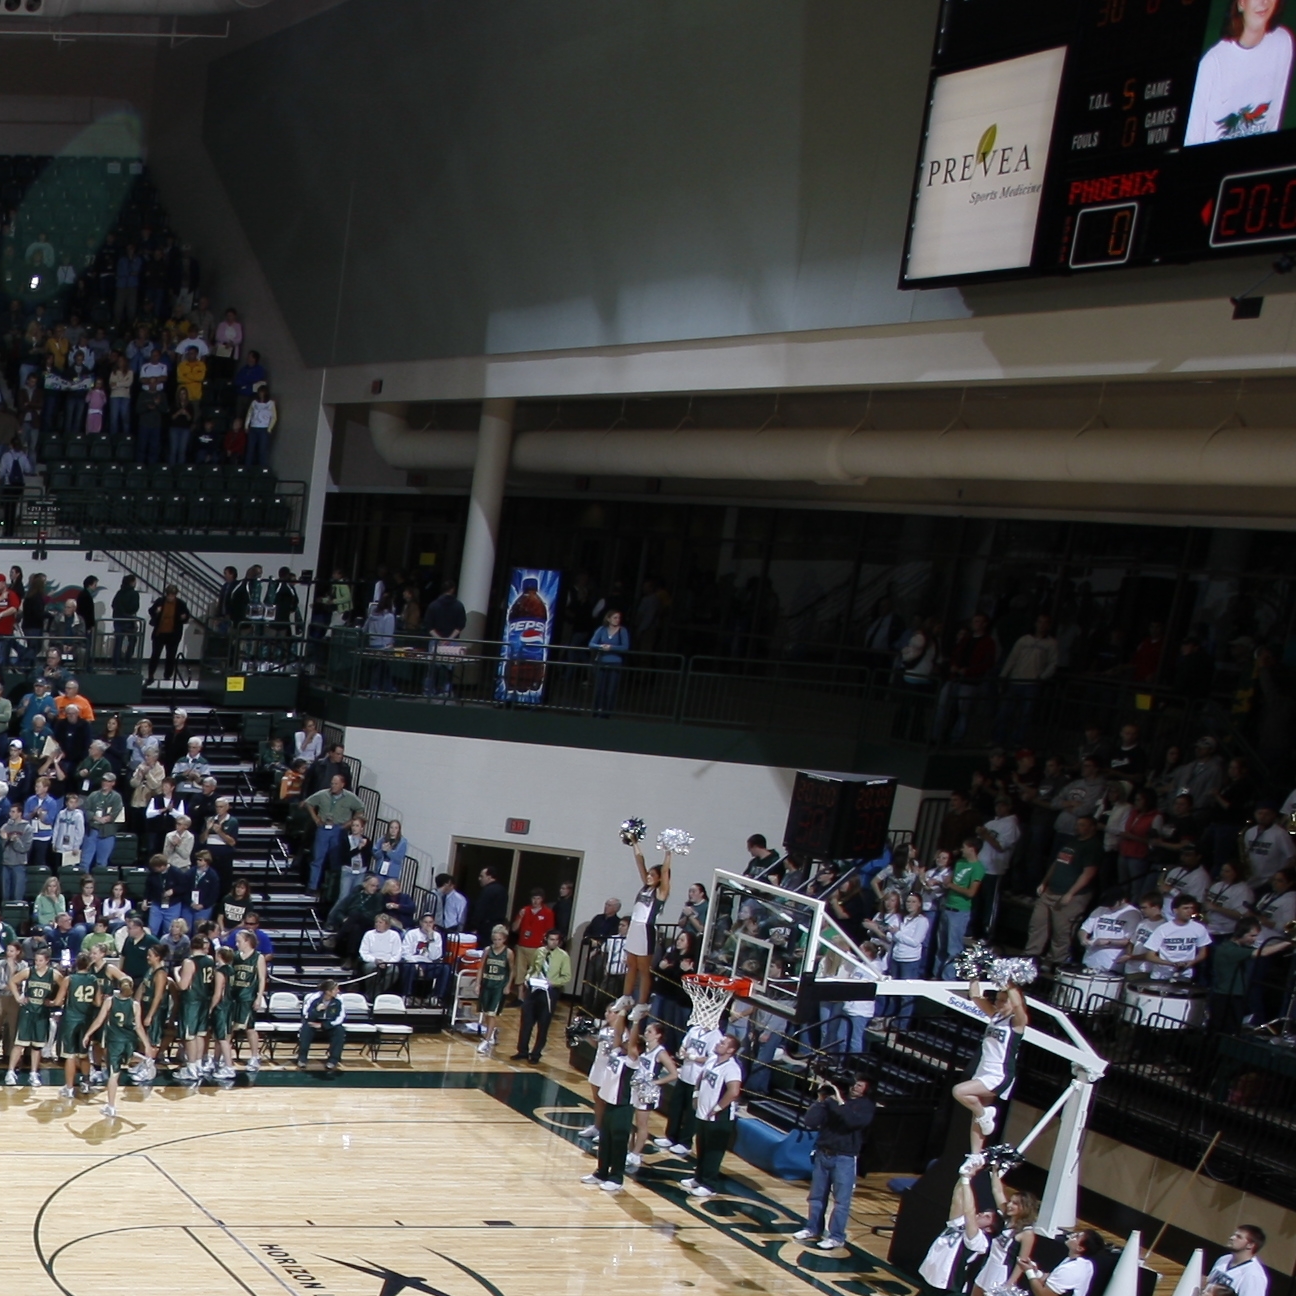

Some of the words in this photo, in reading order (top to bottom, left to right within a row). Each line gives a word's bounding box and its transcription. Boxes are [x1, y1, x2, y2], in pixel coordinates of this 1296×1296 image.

[1144, 80, 1171, 101] GAME
[1144, 107, 1177, 129] GAMES
[1070, 131, 1100, 152] FOULS
[1146, 127, 1169, 145] WON
[926, 144, 1032, 187] PREVEA
[968, 187, 999, 205] Sports
[999, 181, 1042, 201] Medicine
[1068, 170, 1160, 205] PHOENIX
[73, 985, 95, 1002] 42
[257, 1242, 327, 1289] HORIZON
